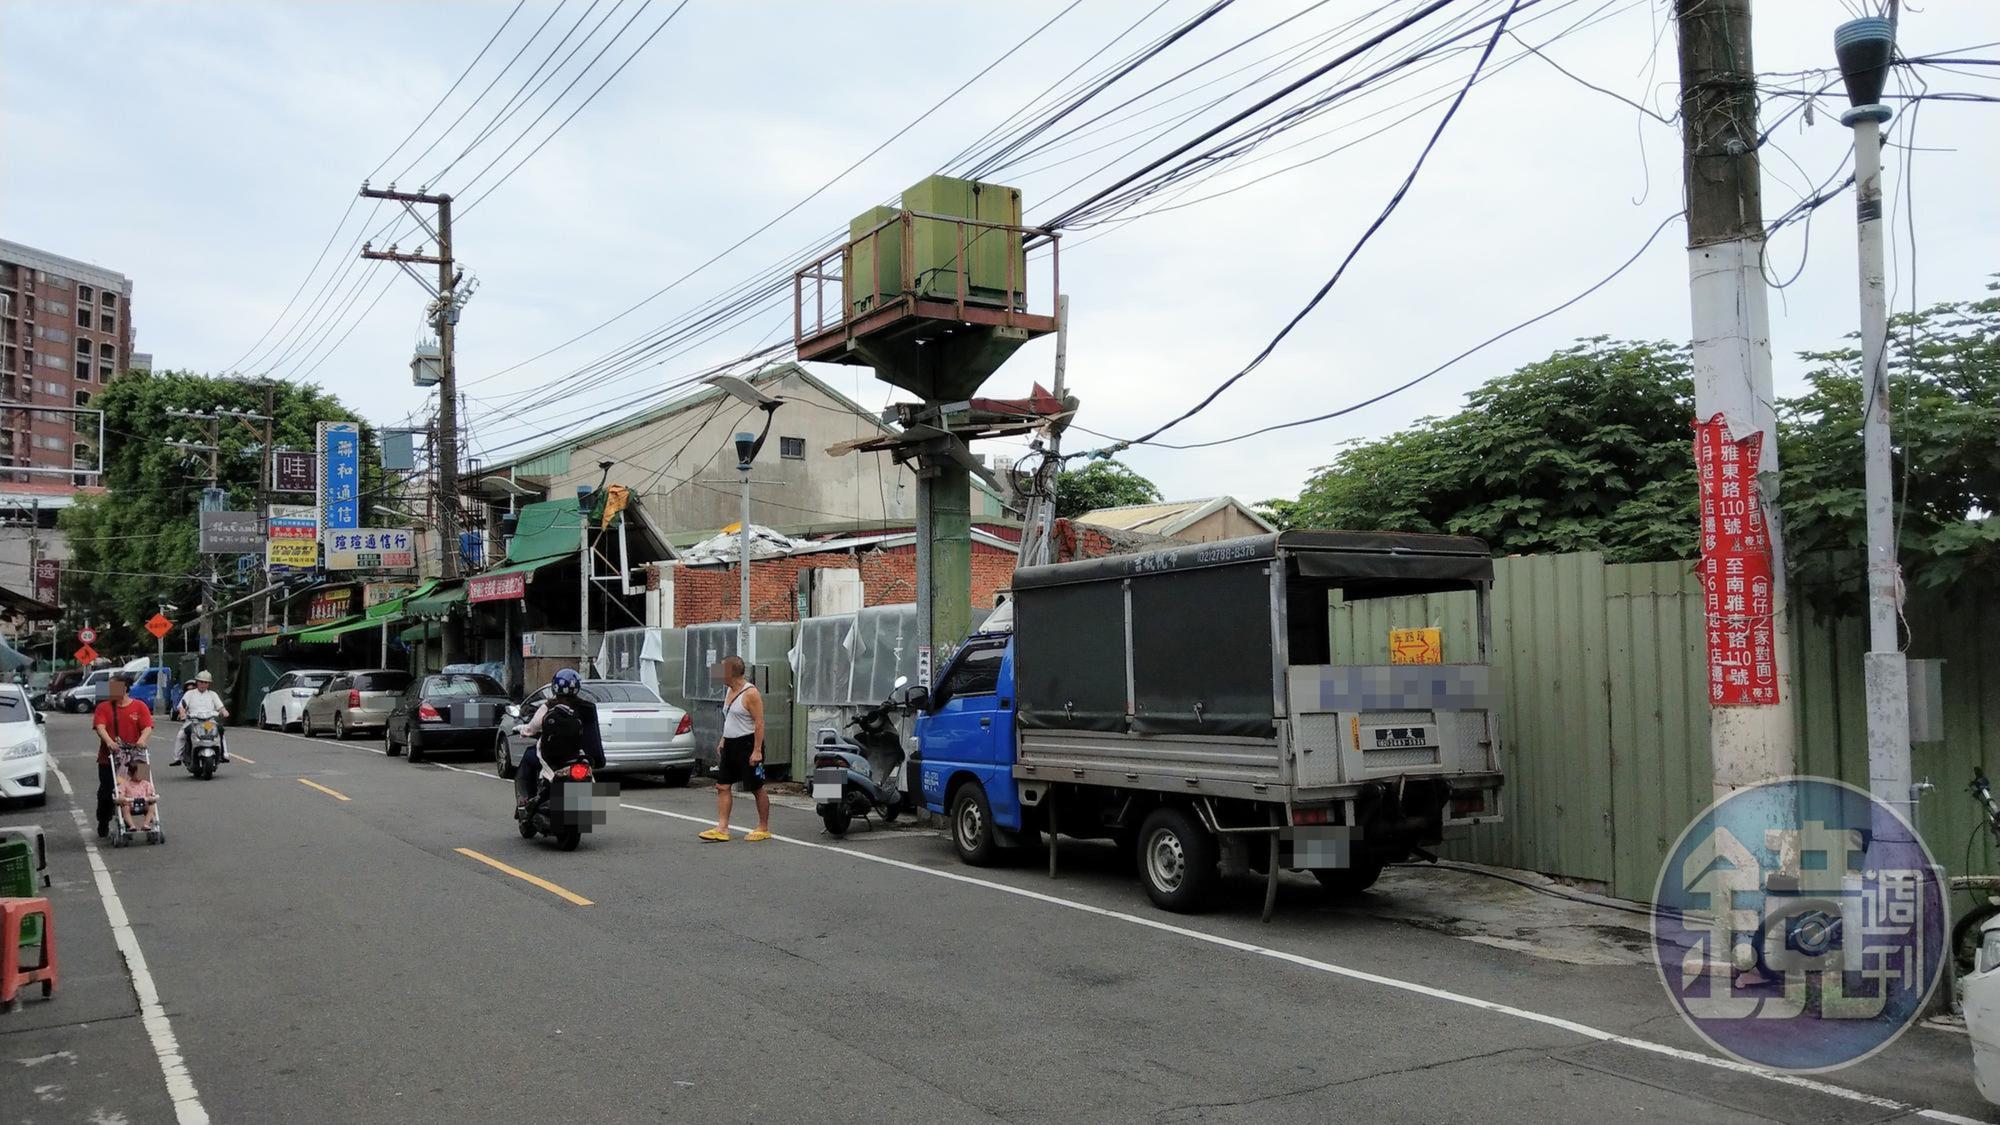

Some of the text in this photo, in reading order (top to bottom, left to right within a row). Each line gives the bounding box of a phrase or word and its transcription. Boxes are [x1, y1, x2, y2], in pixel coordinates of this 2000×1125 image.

[282, 455, 307, 478] 哇
[336, 440, 353, 523] 聯和通信
[1706, 558, 1725, 700] 自6月起本店遷移
[1723, 557, 1752, 686] 至南雅東路110號
